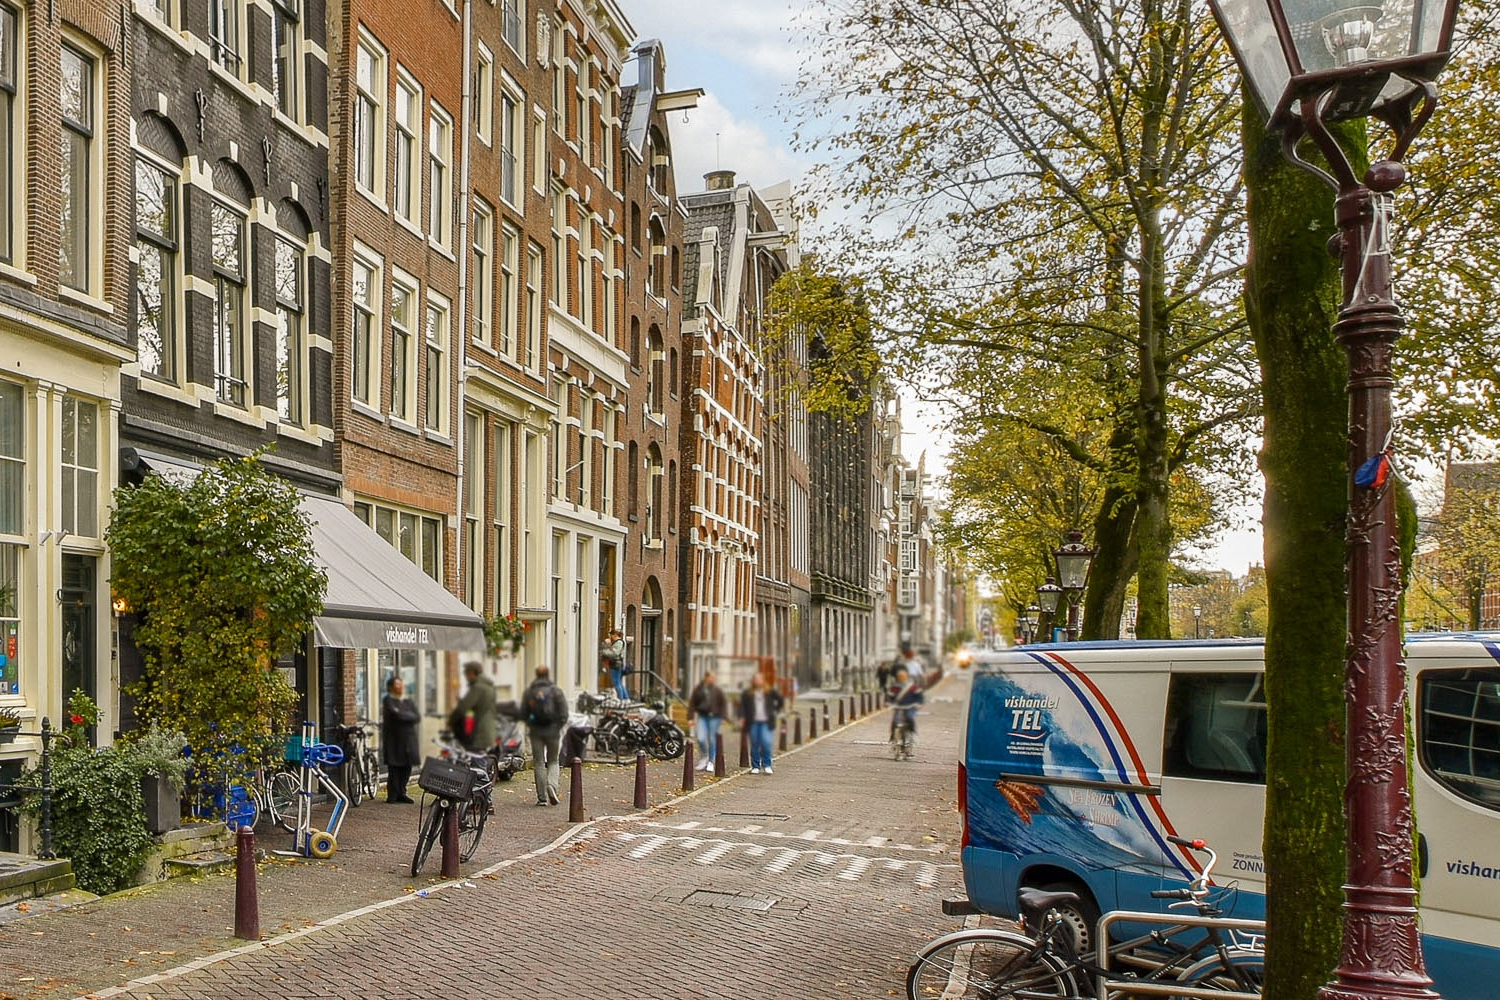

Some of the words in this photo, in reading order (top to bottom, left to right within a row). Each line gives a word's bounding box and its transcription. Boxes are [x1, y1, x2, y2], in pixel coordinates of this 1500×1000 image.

[386, 626, 417, 644] vishandel
[418, 628, 429, 644] TEL
[1004, 695, 1060, 709] vishandel
[1011, 709, 1042, 731] TEL
[1232, 859, 1266, 873] ZONN
